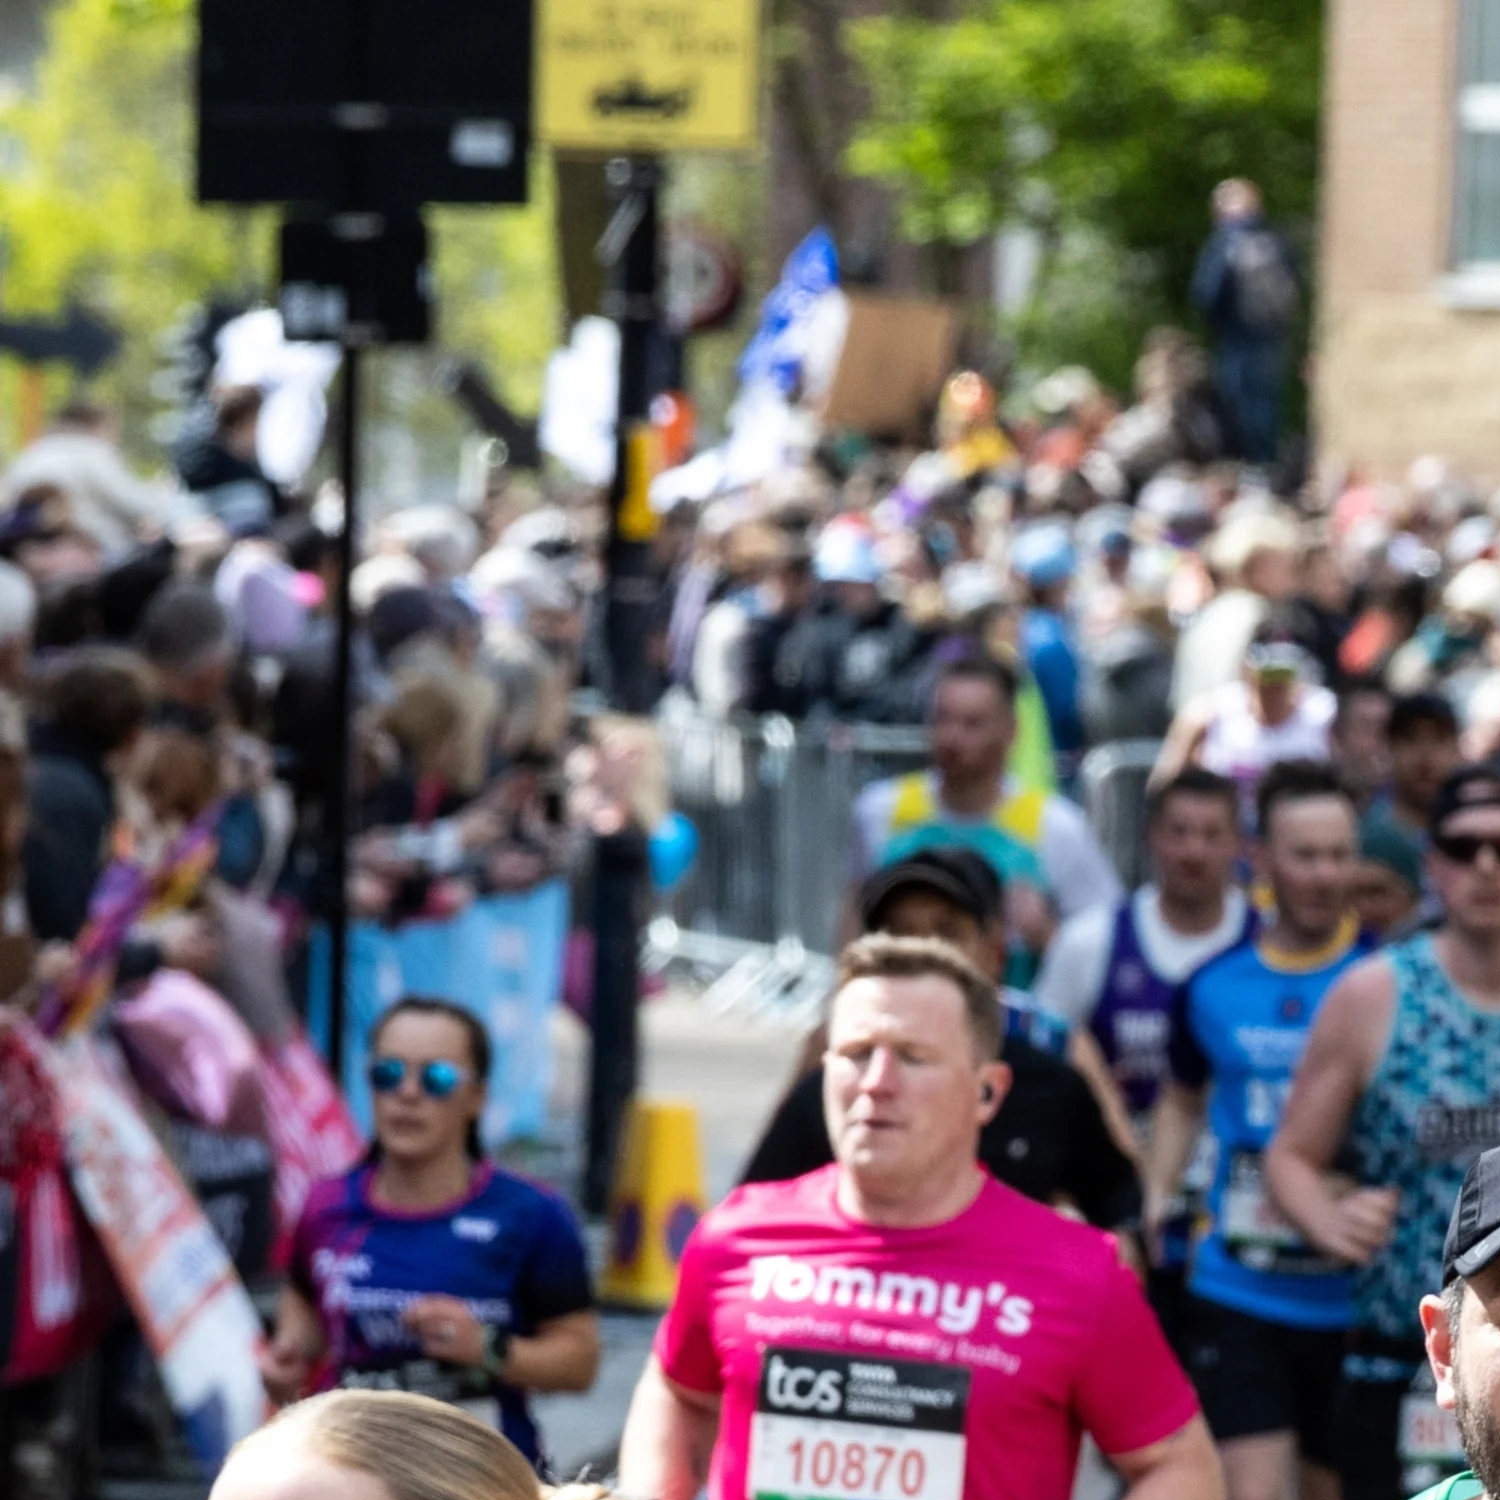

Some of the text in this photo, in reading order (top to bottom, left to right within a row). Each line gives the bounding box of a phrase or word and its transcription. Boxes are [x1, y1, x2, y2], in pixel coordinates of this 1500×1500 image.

[750, 1255, 1034, 1336] Tommy's
[766, 1355, 843, 1413] tcs
[788, 1438, 926, 1497] 10870
